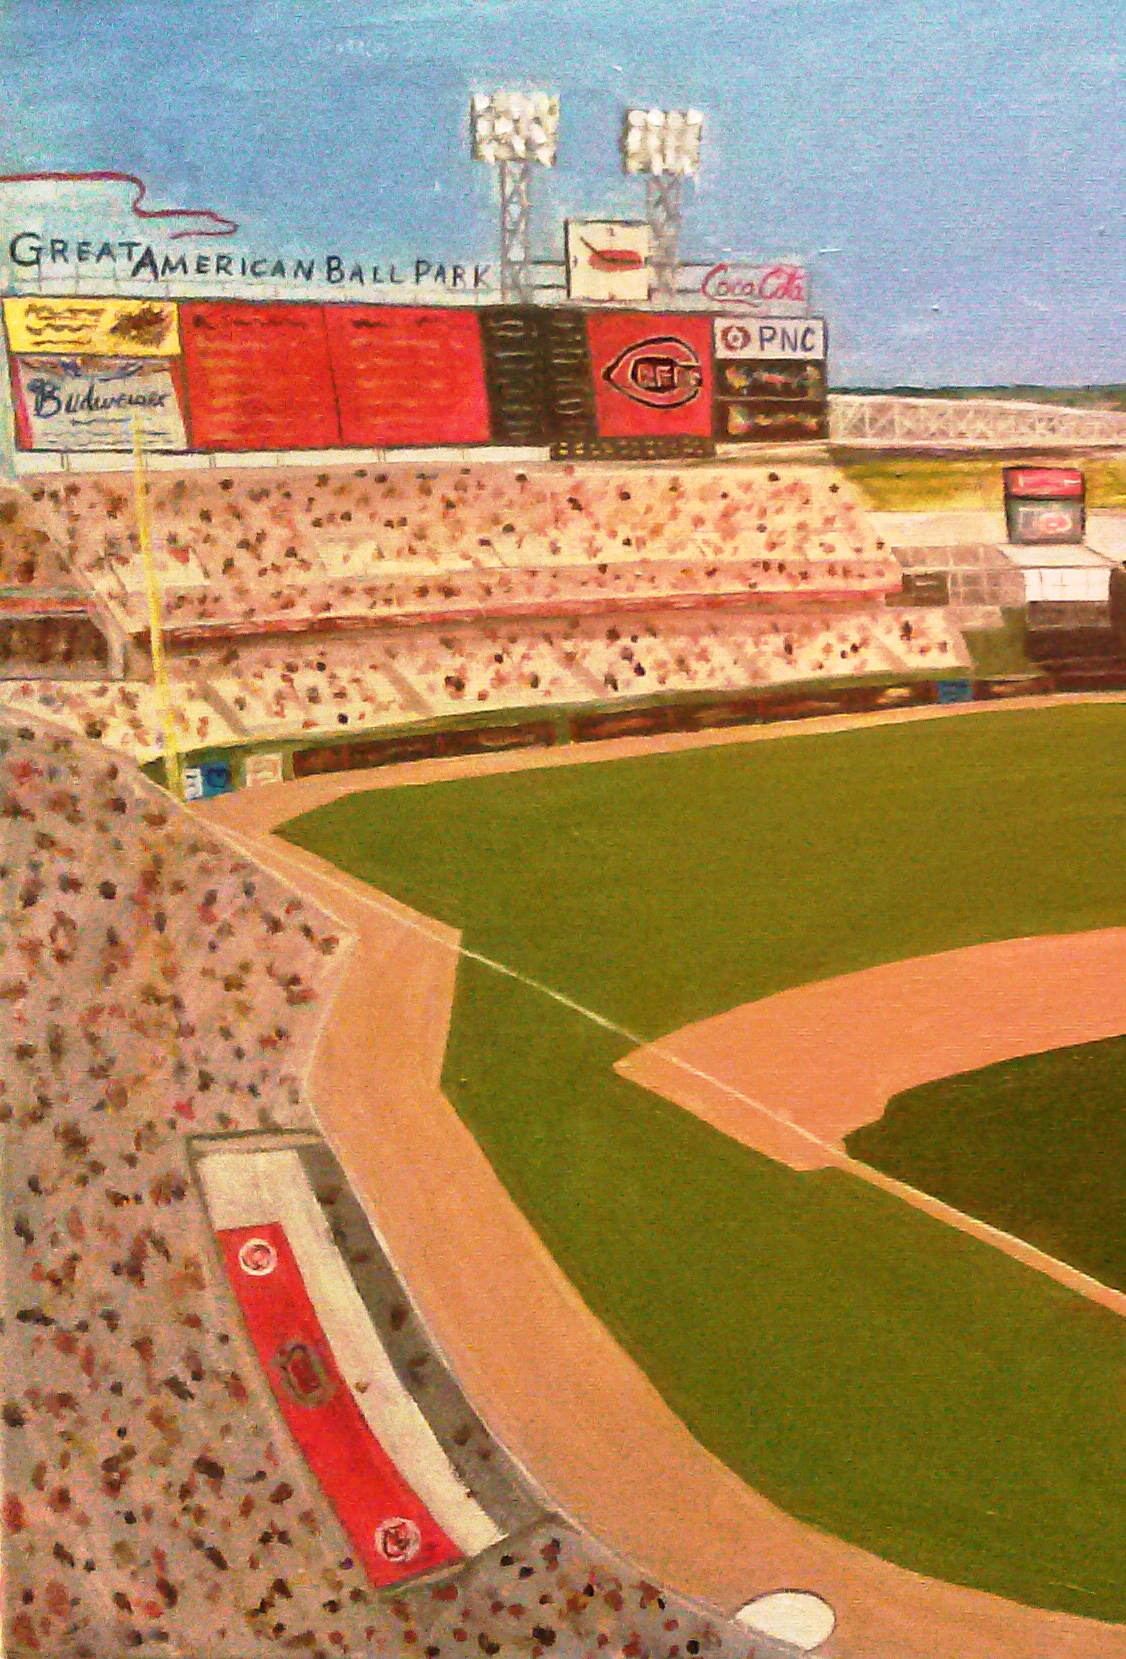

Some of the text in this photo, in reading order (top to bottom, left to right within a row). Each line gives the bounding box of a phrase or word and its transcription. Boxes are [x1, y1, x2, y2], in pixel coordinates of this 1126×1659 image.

[9, 232, 491, 289] GREAT AMERICAN BALL PARK
[758, 325, 816, 352] PNC
